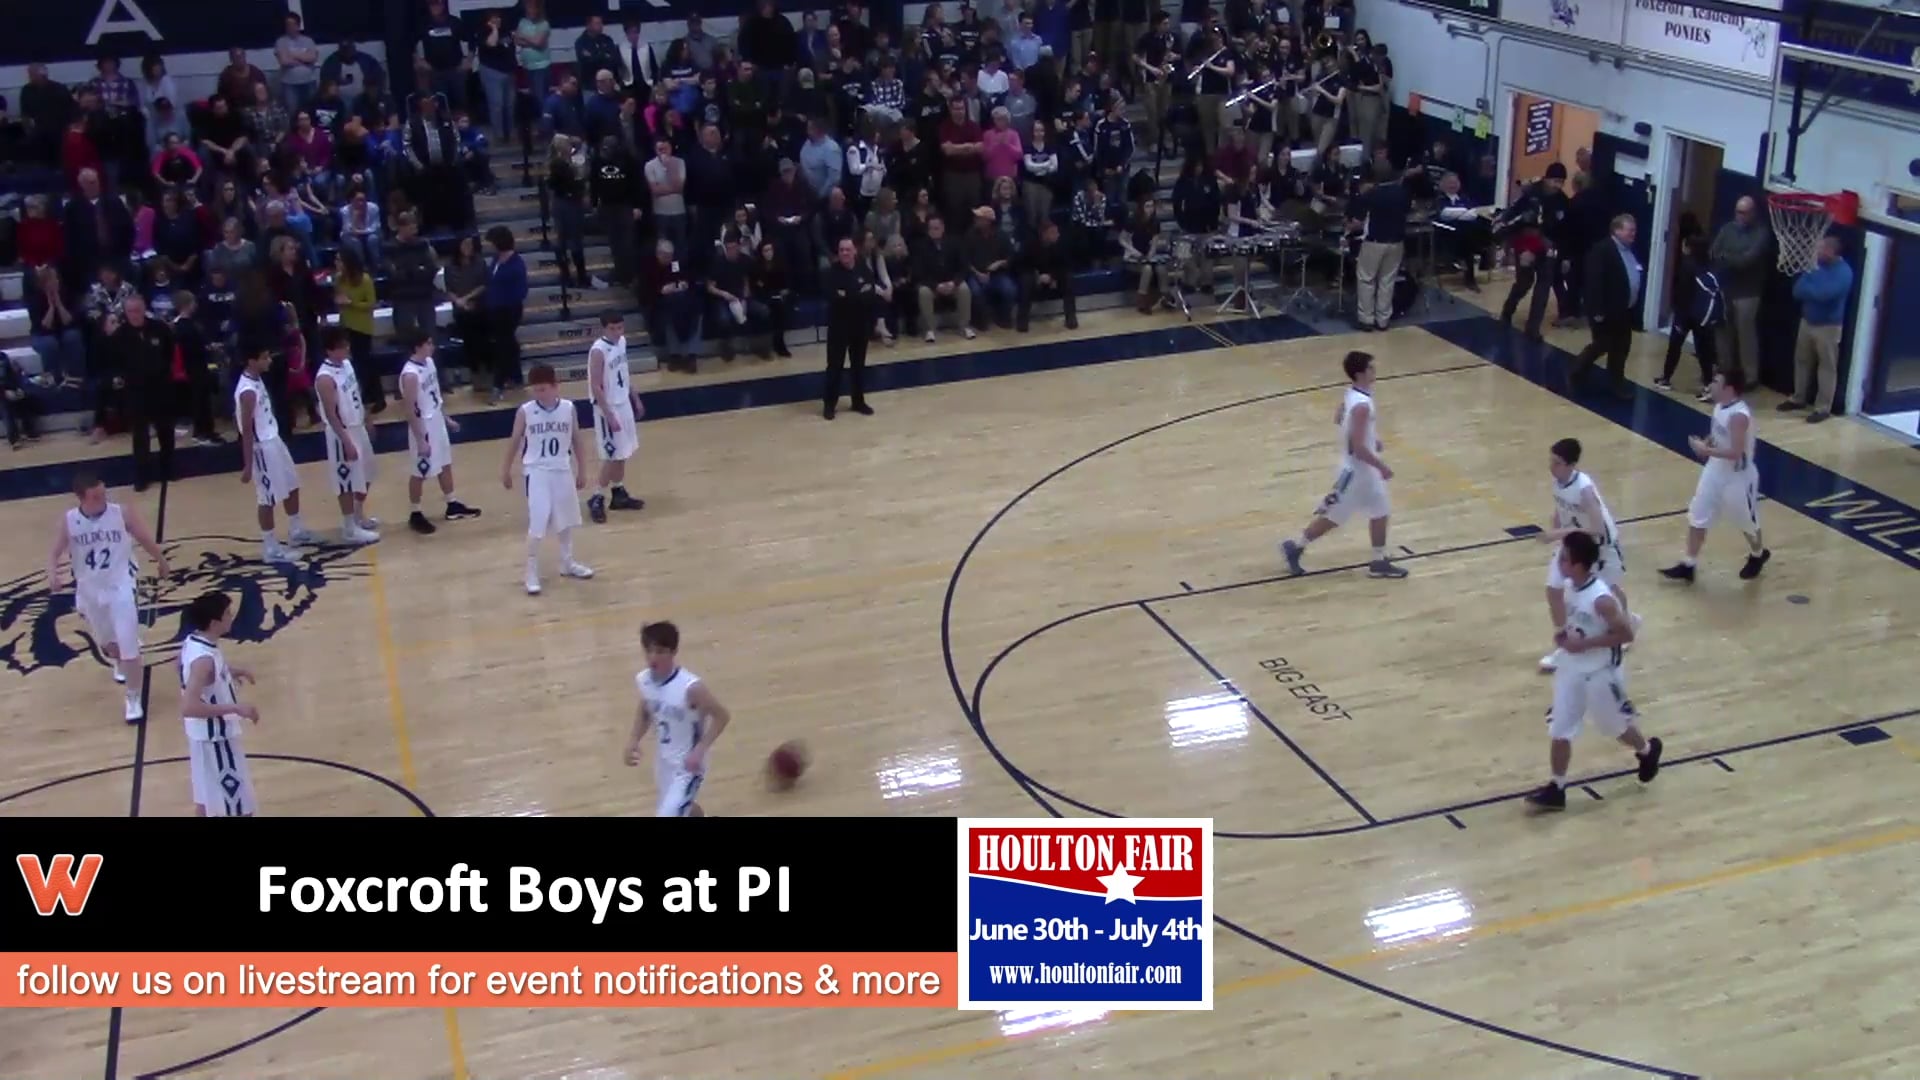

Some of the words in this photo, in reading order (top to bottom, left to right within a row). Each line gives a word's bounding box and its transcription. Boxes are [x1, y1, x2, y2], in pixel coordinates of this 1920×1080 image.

[1664, 21, 1712, 44] PONIES
[528, 420, 570, 434] WILDCATS
[539, 437, 560, 457] 10
[1803, 489, 1920, 559] WIL
[84, 547, 111, 571] 42
[1259, 657, 1304, 683] BIG
[1288, 683, 1352, 720] EAST
